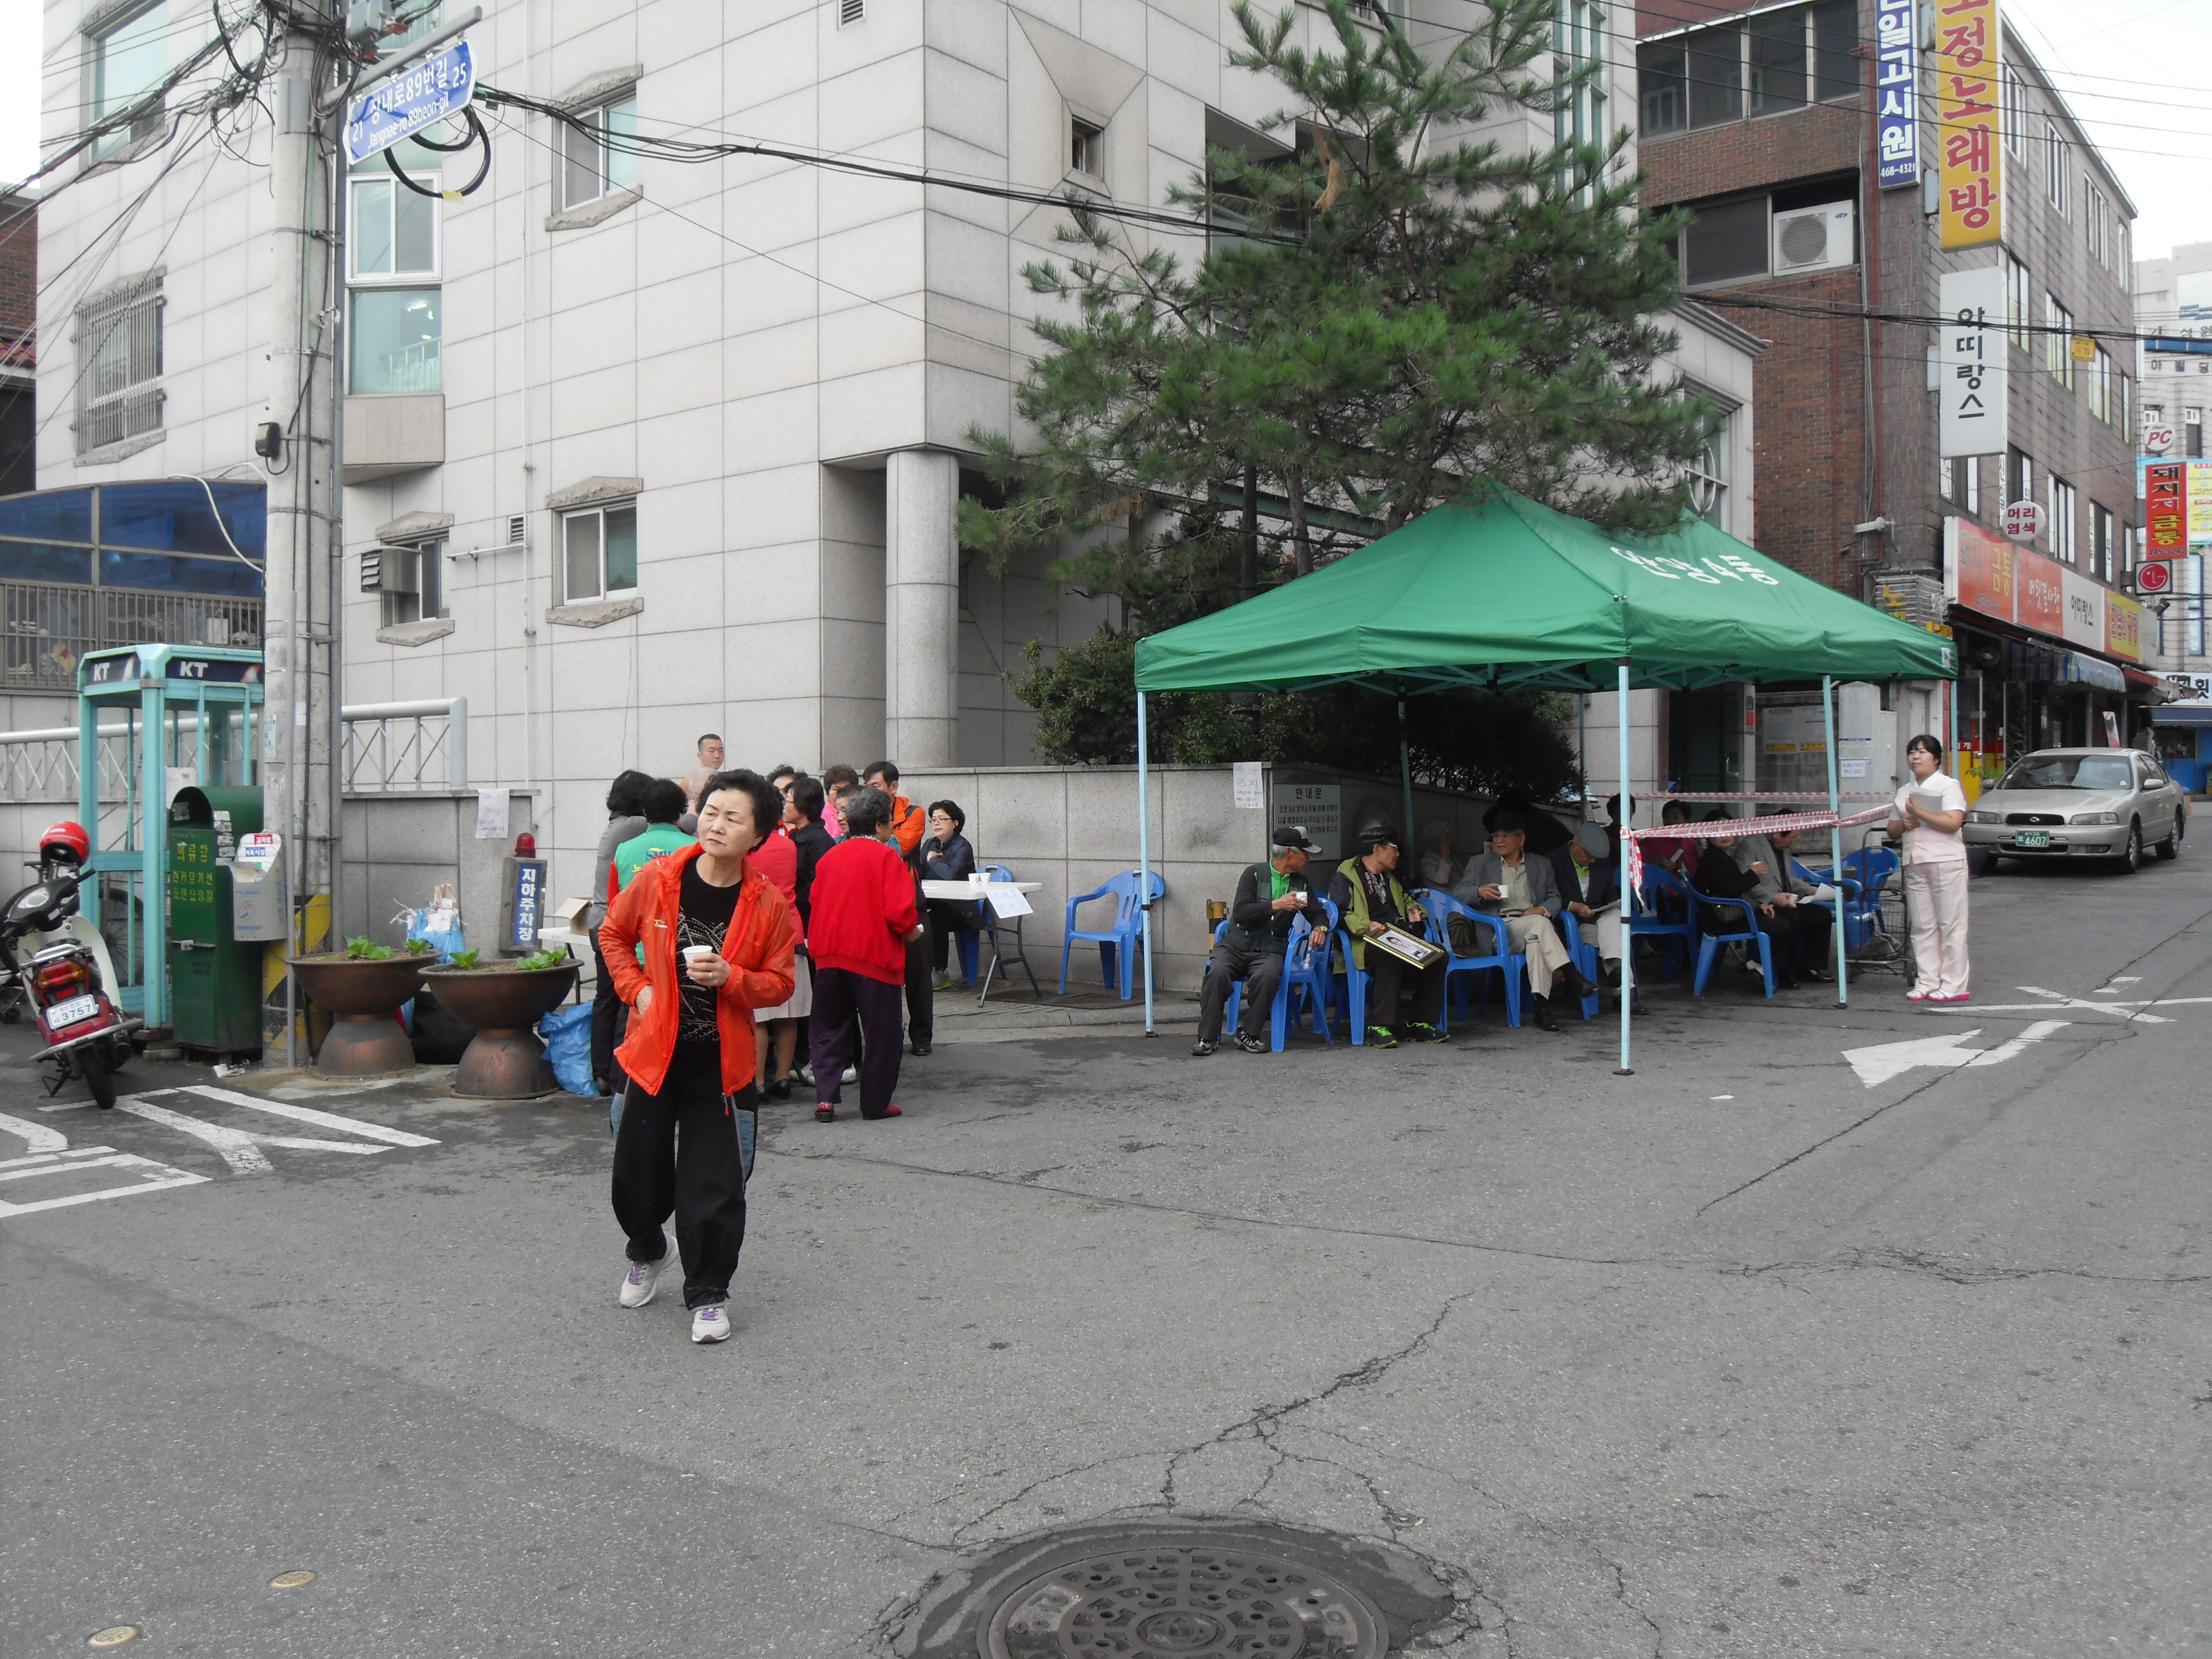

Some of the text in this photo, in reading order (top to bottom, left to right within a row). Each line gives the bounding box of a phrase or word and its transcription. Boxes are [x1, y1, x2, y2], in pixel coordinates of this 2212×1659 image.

[370, 57, 467, 125] 장내로89번길 25
[352, 91, 449, 149] 21 Jangnae-ro 89beon-gil
[1880, 162, 1916, 178] 468-4321
[1955, 306, 1986, 419] 아띠랑스
[2146, 429, 2173, 446] PC
[2007, 507, 2036, 520] 머리
[2007, 522, 2036, 535] 염색
[1610, 546, 1780, 586] 안양4동
[2028, 579, 2061, 615] 머릿결사랑
[2070, 594, 2093, 627] 아띠랑스
[93, 662, 110, 682] KT
[180, 661, 208, 677] KT
[1295, 787, 1322, 799] 안내문
[2024, 836, 2047, 846] 4607
[518, 868, 537, 941] 지하주차장
[61, 1004, 91, 1021] 3757
